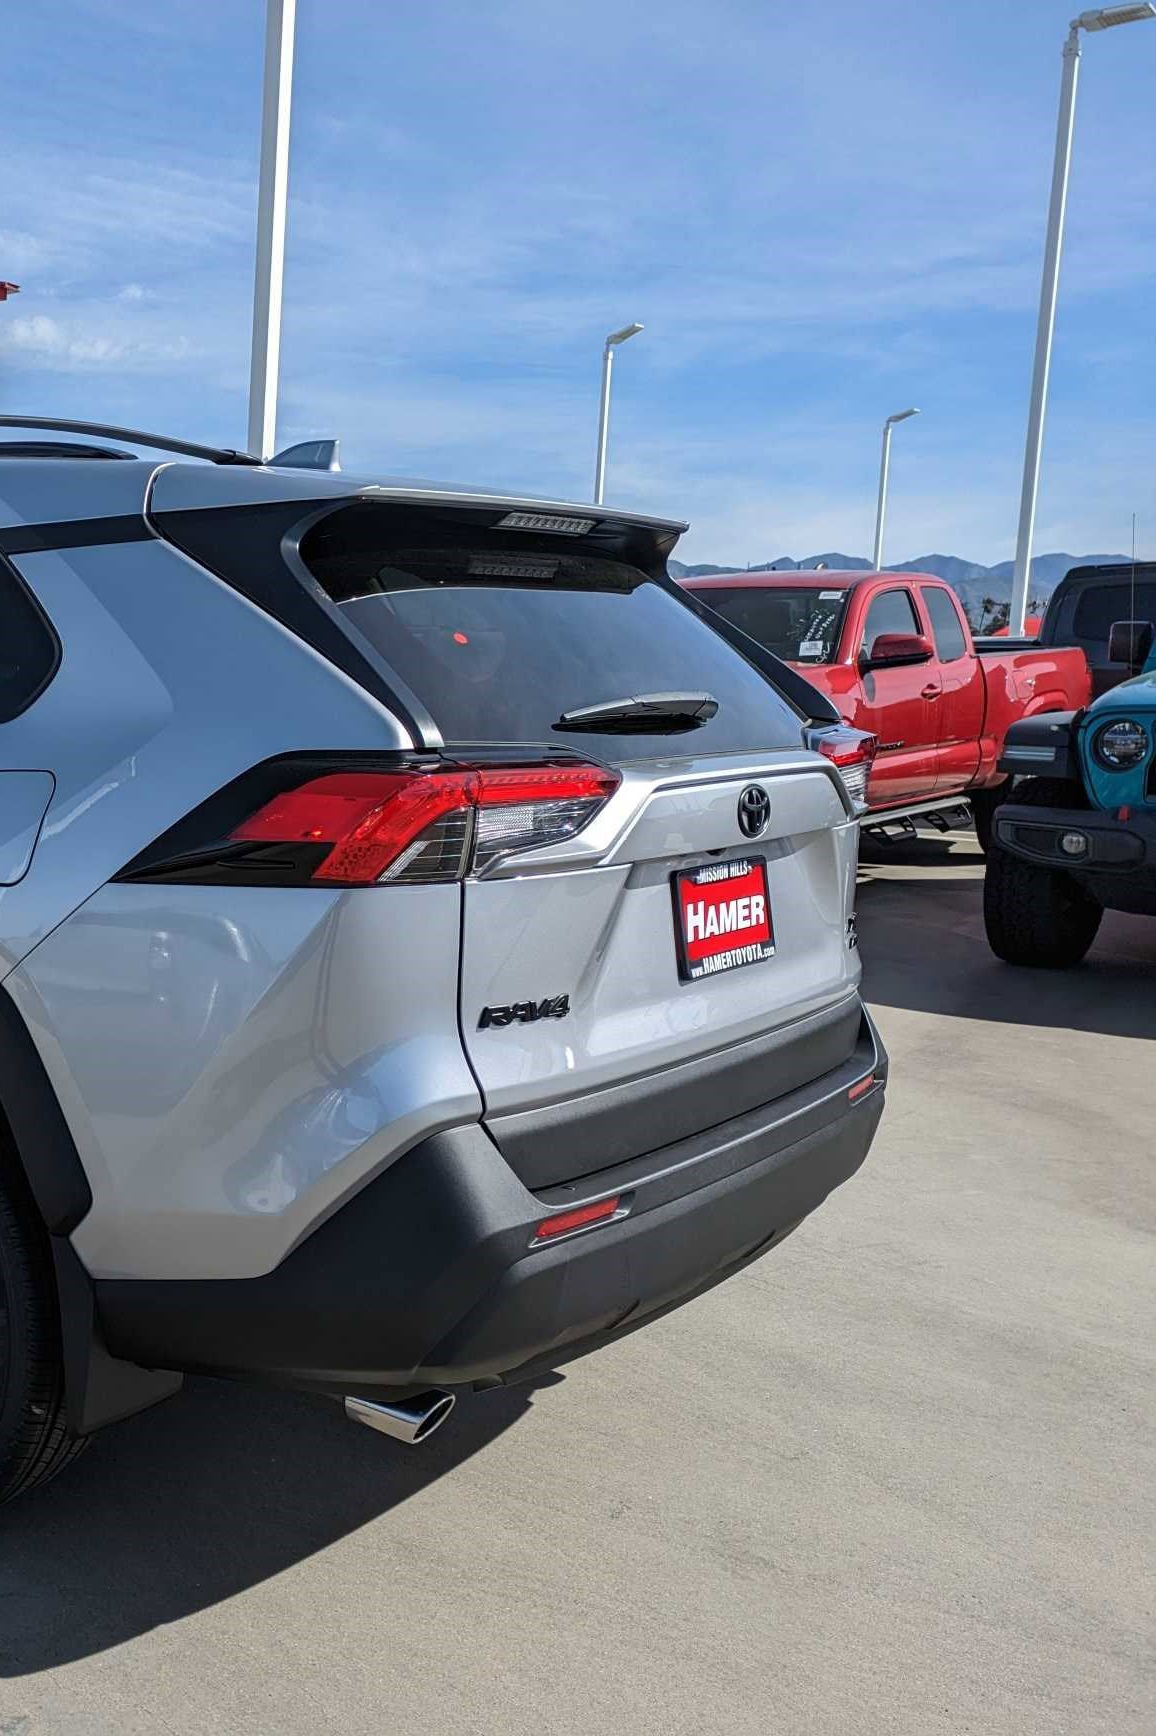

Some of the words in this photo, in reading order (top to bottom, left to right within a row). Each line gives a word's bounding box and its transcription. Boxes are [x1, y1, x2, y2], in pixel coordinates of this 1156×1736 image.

[697, 863, 729, 884] MISSION
[730, 860, 749, 878] HILLS
[686, 894, 765, 943] HAMER
[690, 943, 775, 979] www.HAMERTOYOTA.com
[476, 993, 570, 1029] RAV4
